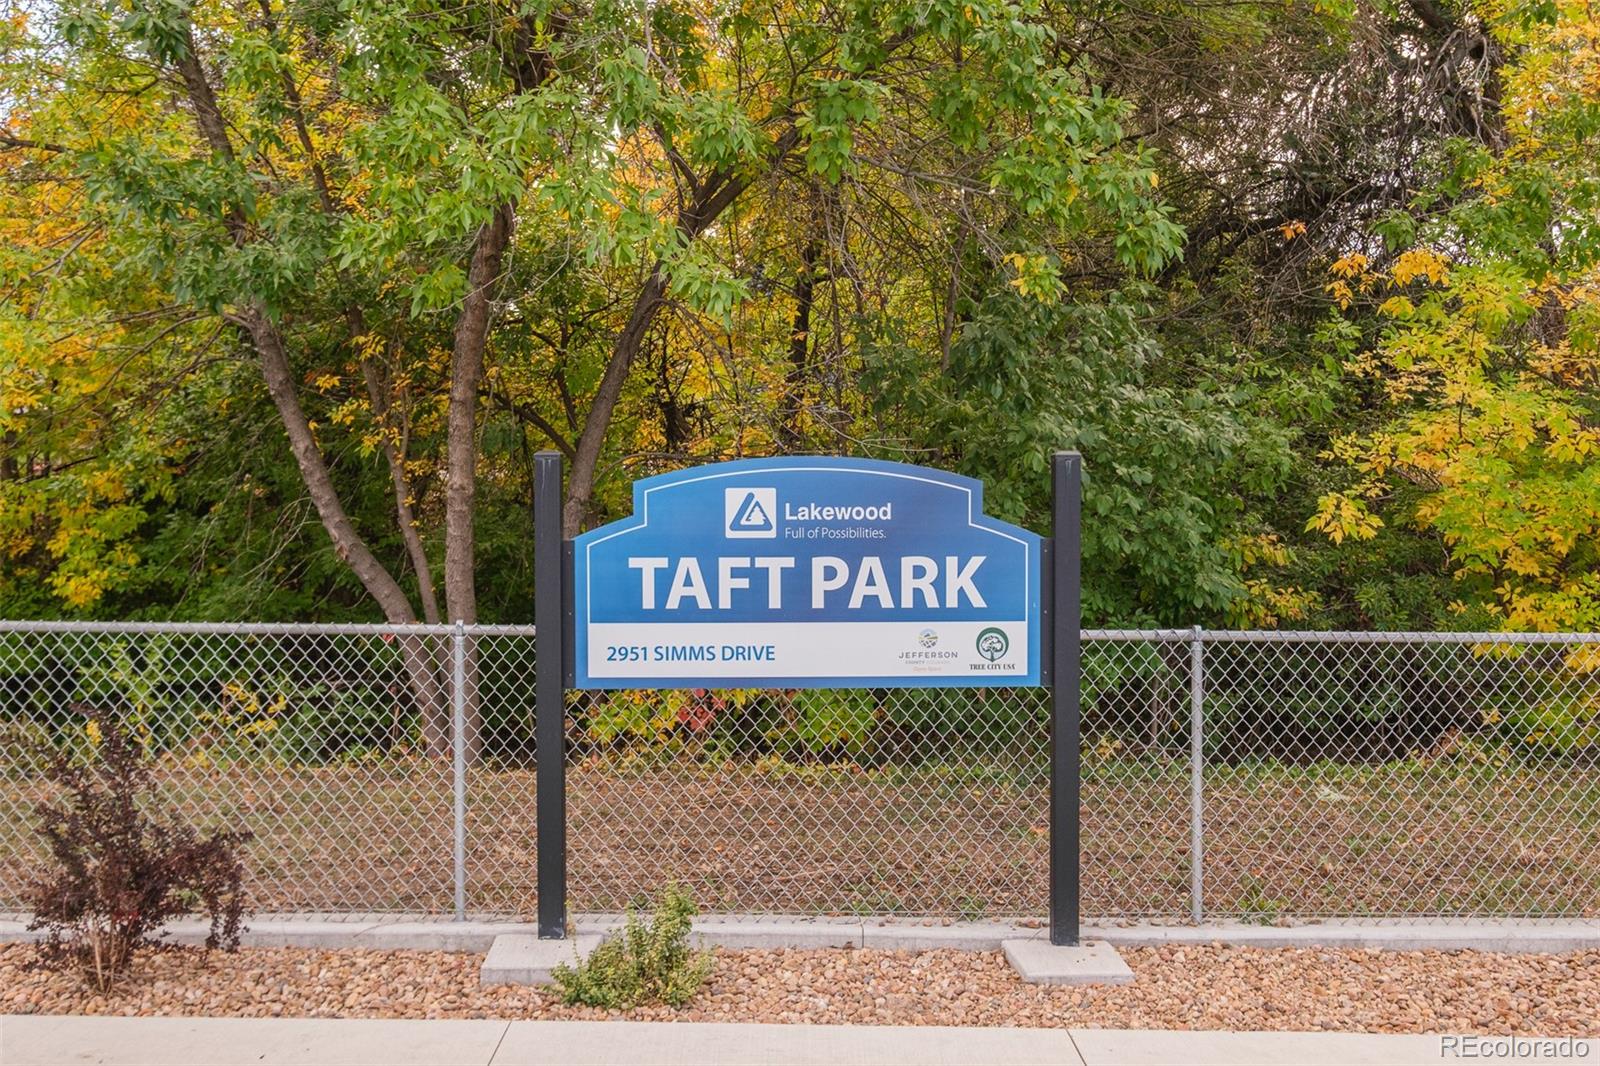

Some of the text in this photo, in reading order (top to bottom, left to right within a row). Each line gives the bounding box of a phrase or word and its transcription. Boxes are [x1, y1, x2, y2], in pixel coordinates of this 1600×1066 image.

[785, 503, 892, 521] Lakewood
[785, 527, 887, 539] Full of Possibilities.
[628, 555, 988, 610] TAFT PARK
[606, 645, 776, 662] 2951 SIMMS DRIVE
[898, 651, 958, 659] JEFFERSON
